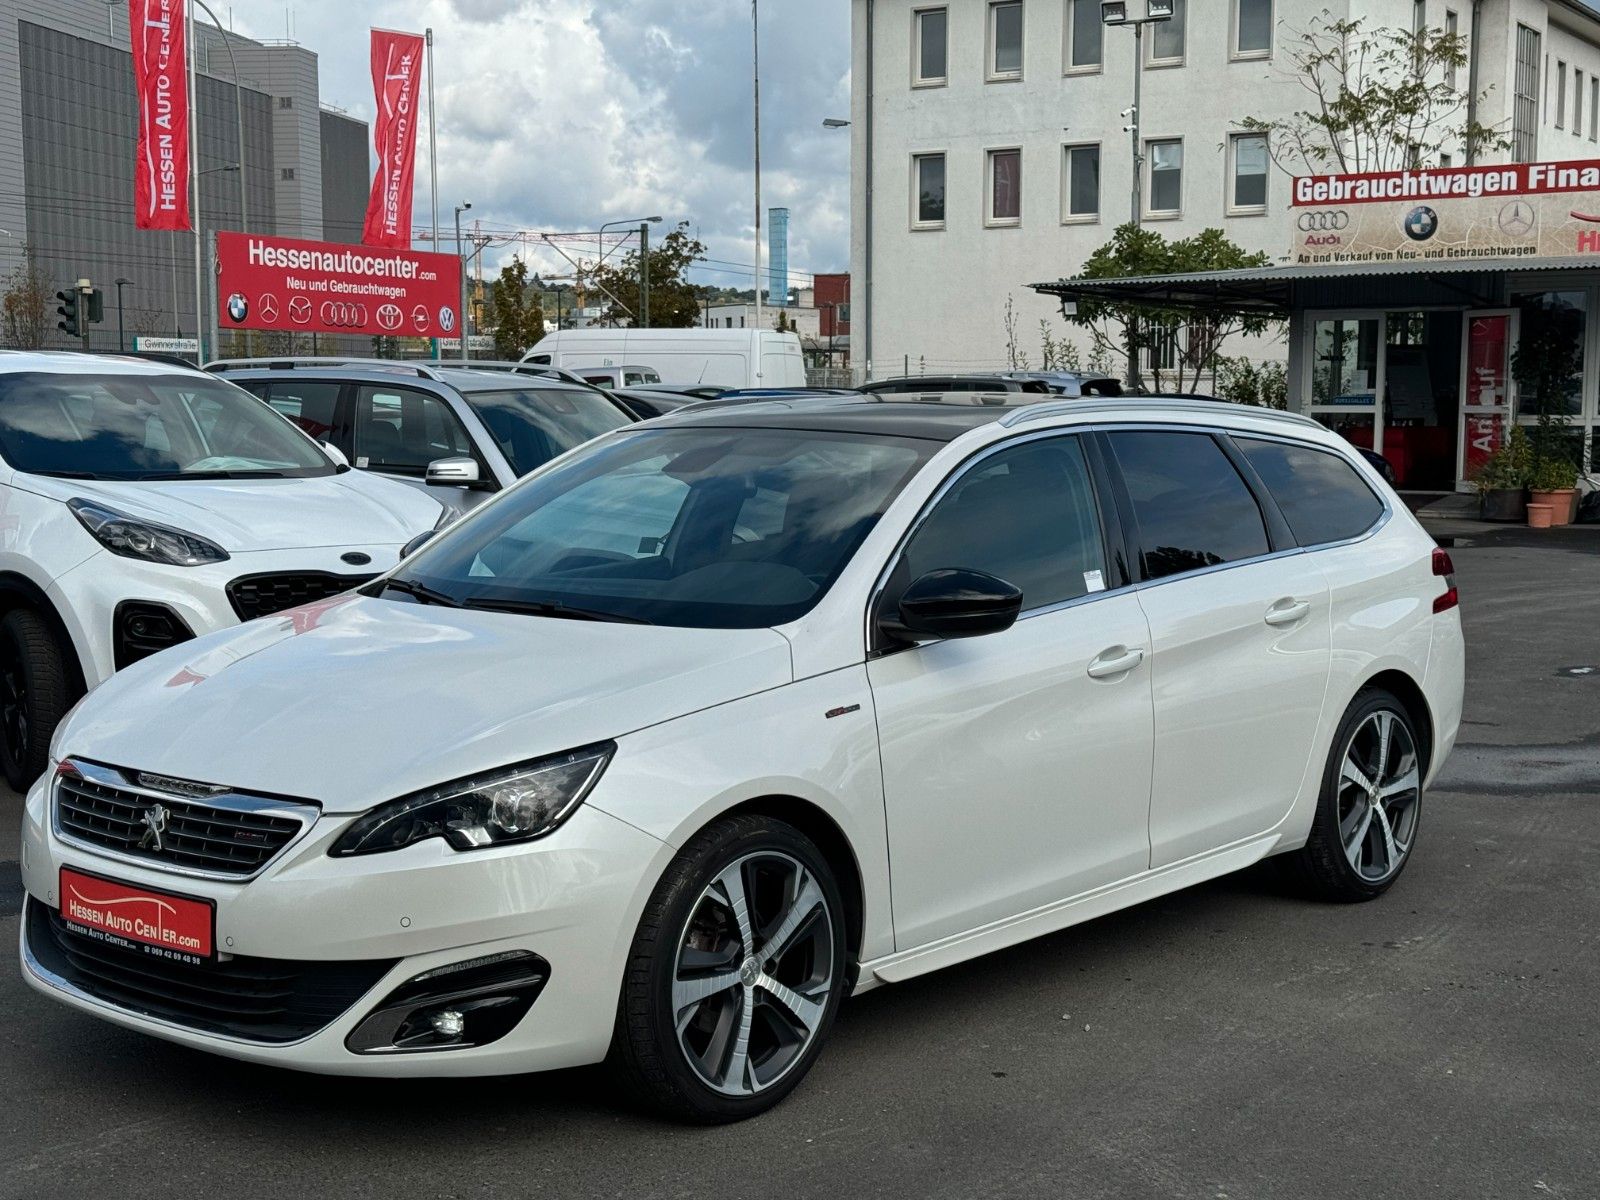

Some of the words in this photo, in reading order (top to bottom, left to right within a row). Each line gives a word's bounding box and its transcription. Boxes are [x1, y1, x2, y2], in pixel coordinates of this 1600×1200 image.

[156, 75, 172, 130] AUTO
[159, 134, 176, 210] HESSEN
[1296, 170, 1518, 202] Gebrauchtwagen
[1528, 164, 1600, 190] Fina
[386, 169, 402, 236] HESSEN
[1304, 234, 1341, 246] Audi
[1577, 230, 1600, 253] H
[1297, 253, 1310, 264] An
[1313, 252, 1330, 262] und
[1334, 251, 1373, 262] Verkauf
[1373, 251, 1393, 260] von
[1396, 250, 1421, 260] Neu-
[1424, 248, 1444, 259] und
[1447, 246, 1537, 258] Gebrauchtwagen
[286, 276, 306, 290] Neu
[308, 278, 328, 292] und
[329, 279, 407, 299] Gebrauchtwagen
[69, 899, 104, 924] HESSEN
[105, 911, 133, 933] AUTO
[151, 947, 163, 957] 069
[164, 950, 173, 959] 42
[191, 956, 201, 965] 98
